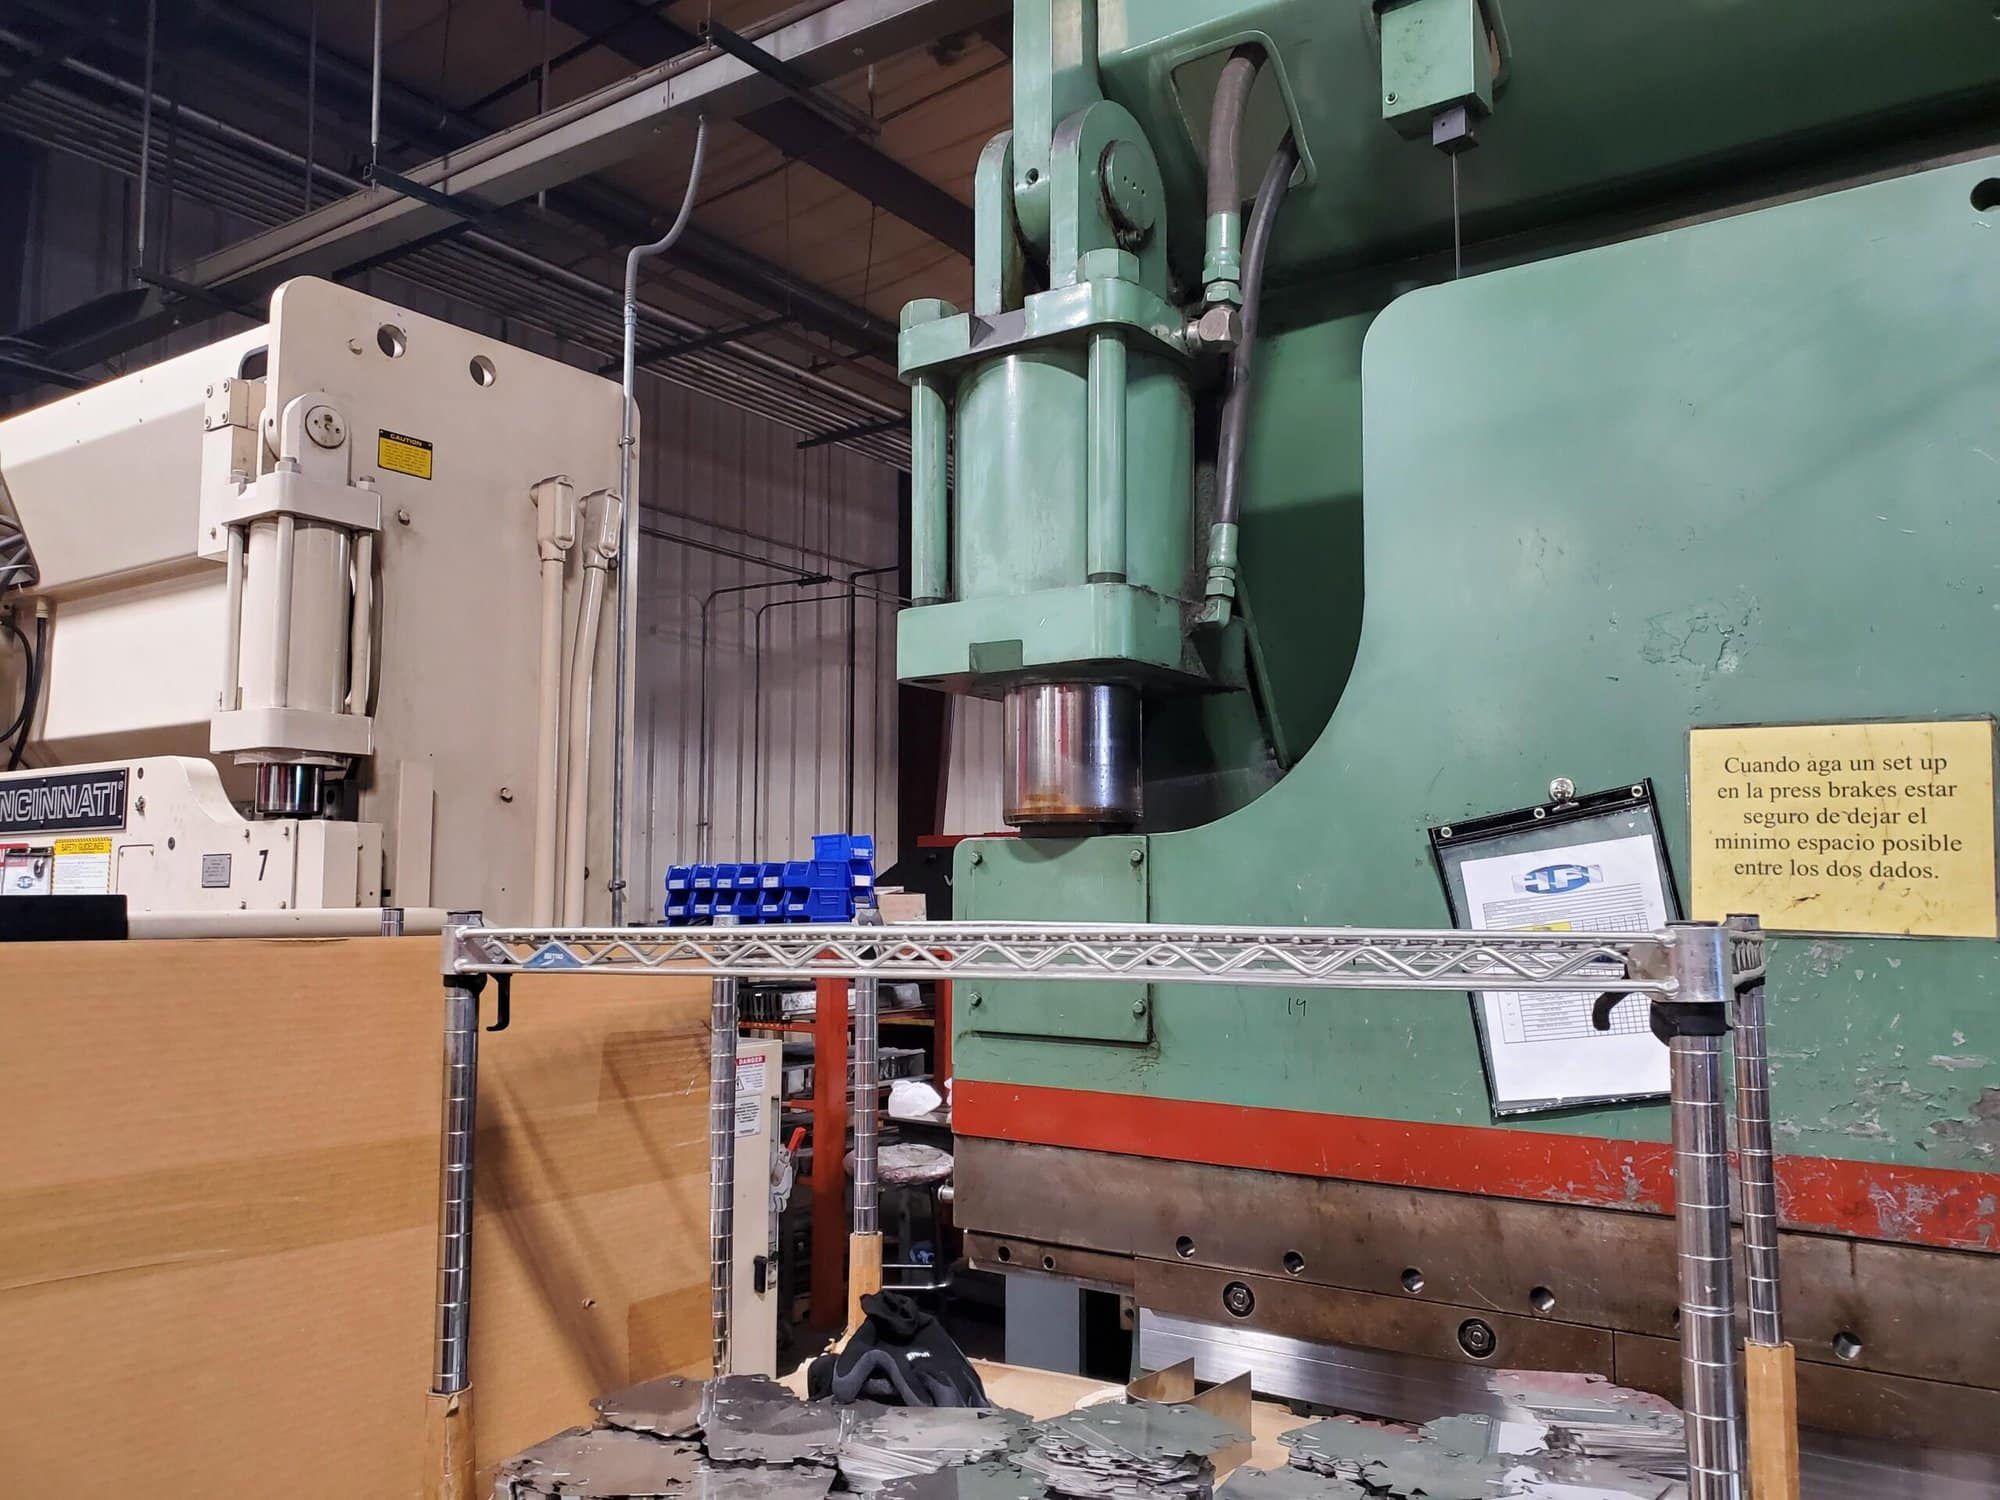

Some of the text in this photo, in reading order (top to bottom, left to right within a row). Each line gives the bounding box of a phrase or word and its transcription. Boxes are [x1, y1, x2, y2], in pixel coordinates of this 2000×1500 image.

[390, 433, 423, 447] CAUTION
[1724, 755, 1948, 777] Cuando aga un set up
[1717, 780, 1958, 804] en la press brakes estar
[1743, 806, 1927, 830] seguro de dejar el
[1714, 832, 1964, 857] minimo espacio posible
[258, 849, 269, 881] 7
[1734, 858, 1940, 880] entre los dos dados.
